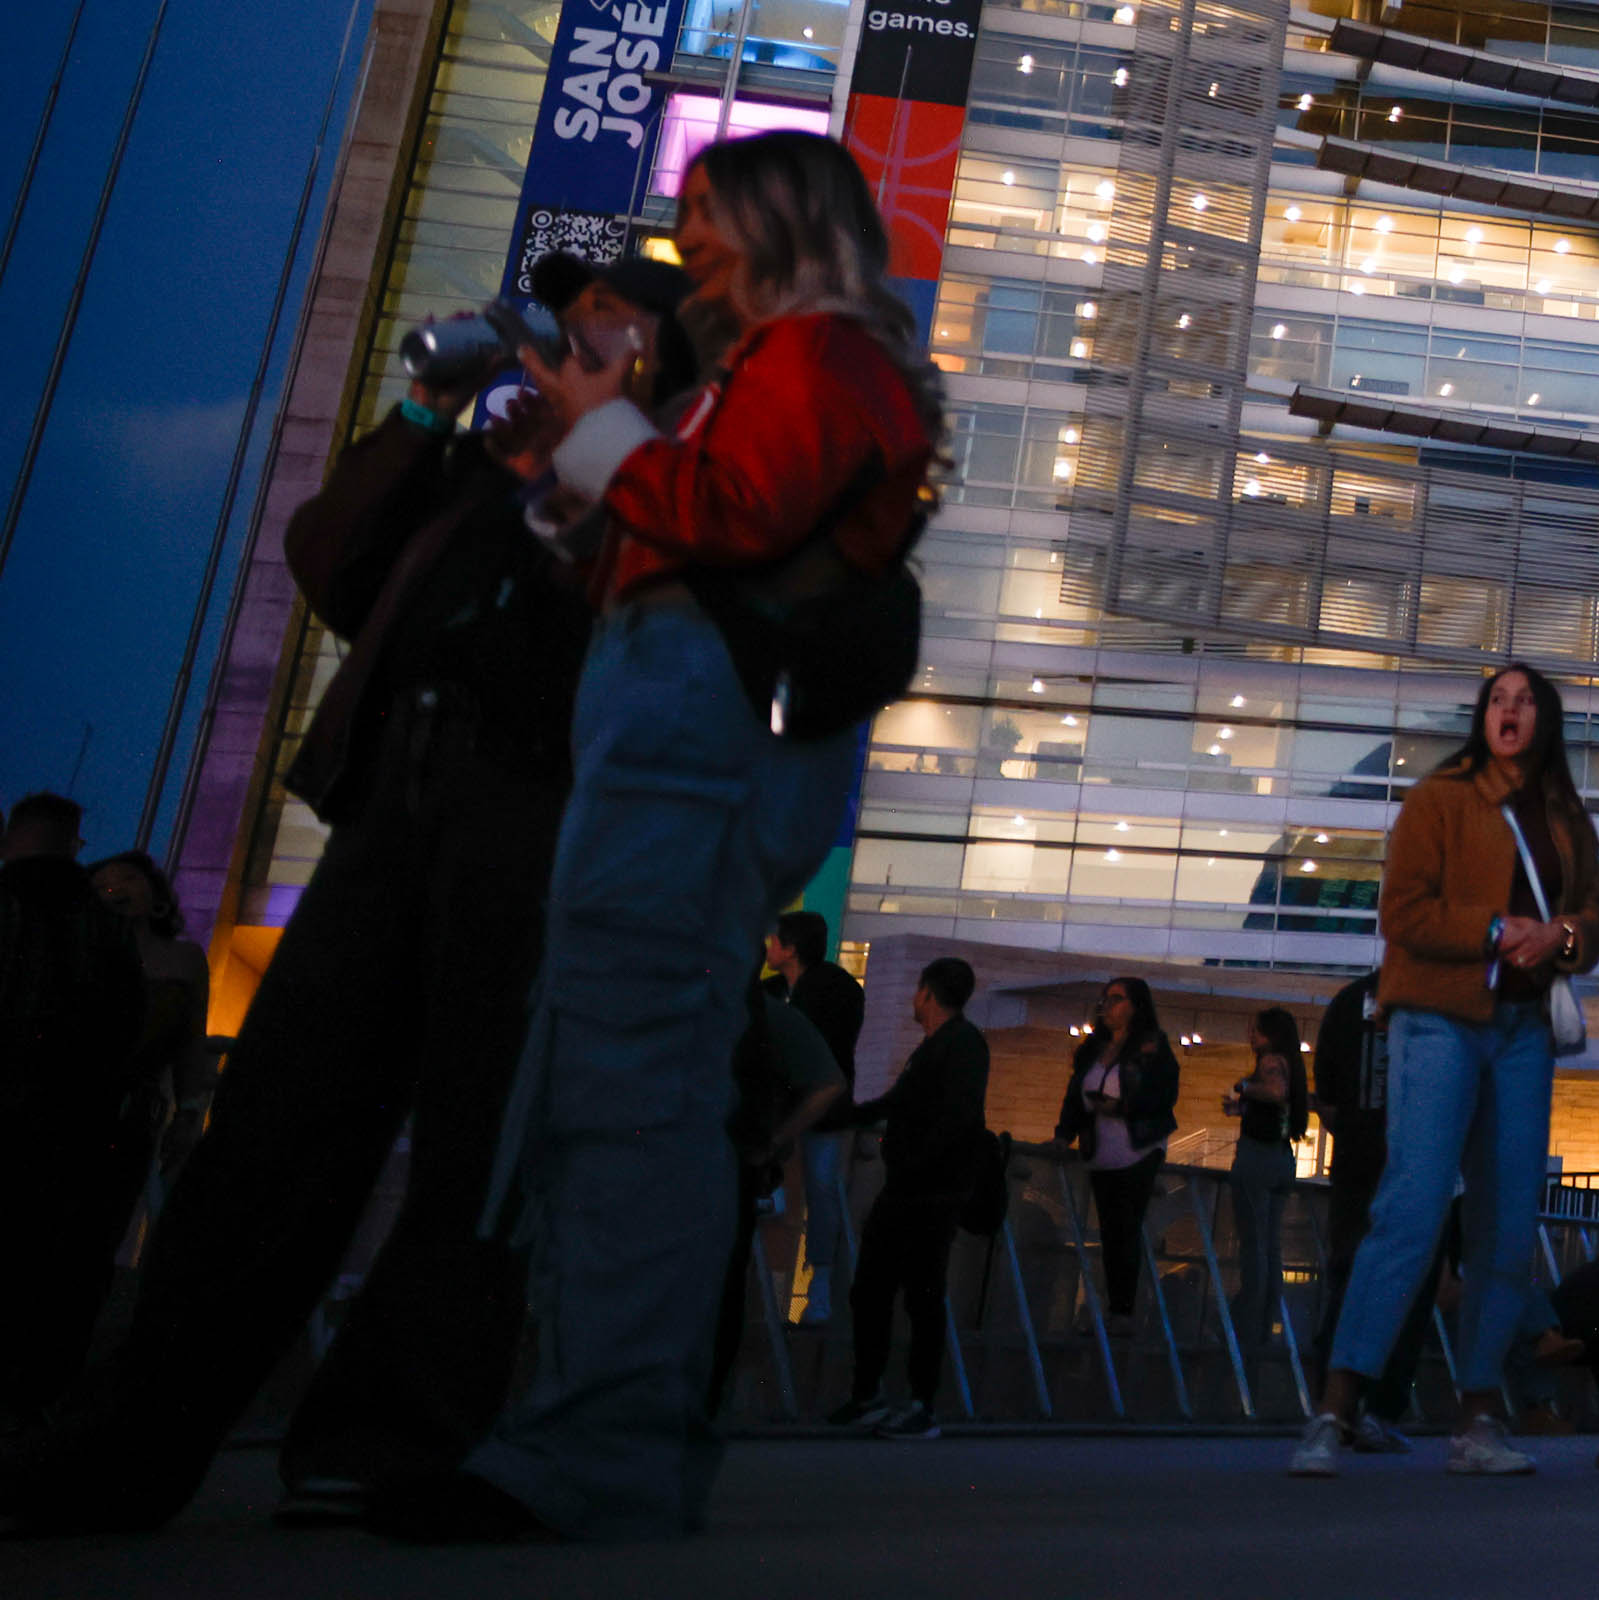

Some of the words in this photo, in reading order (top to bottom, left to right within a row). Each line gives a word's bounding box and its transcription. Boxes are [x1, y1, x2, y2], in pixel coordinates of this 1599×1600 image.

[601, 2, 668, 149] JOSÉ
[868, 9, 976, 39] games.
[554, 27, 617, 142] SAN
